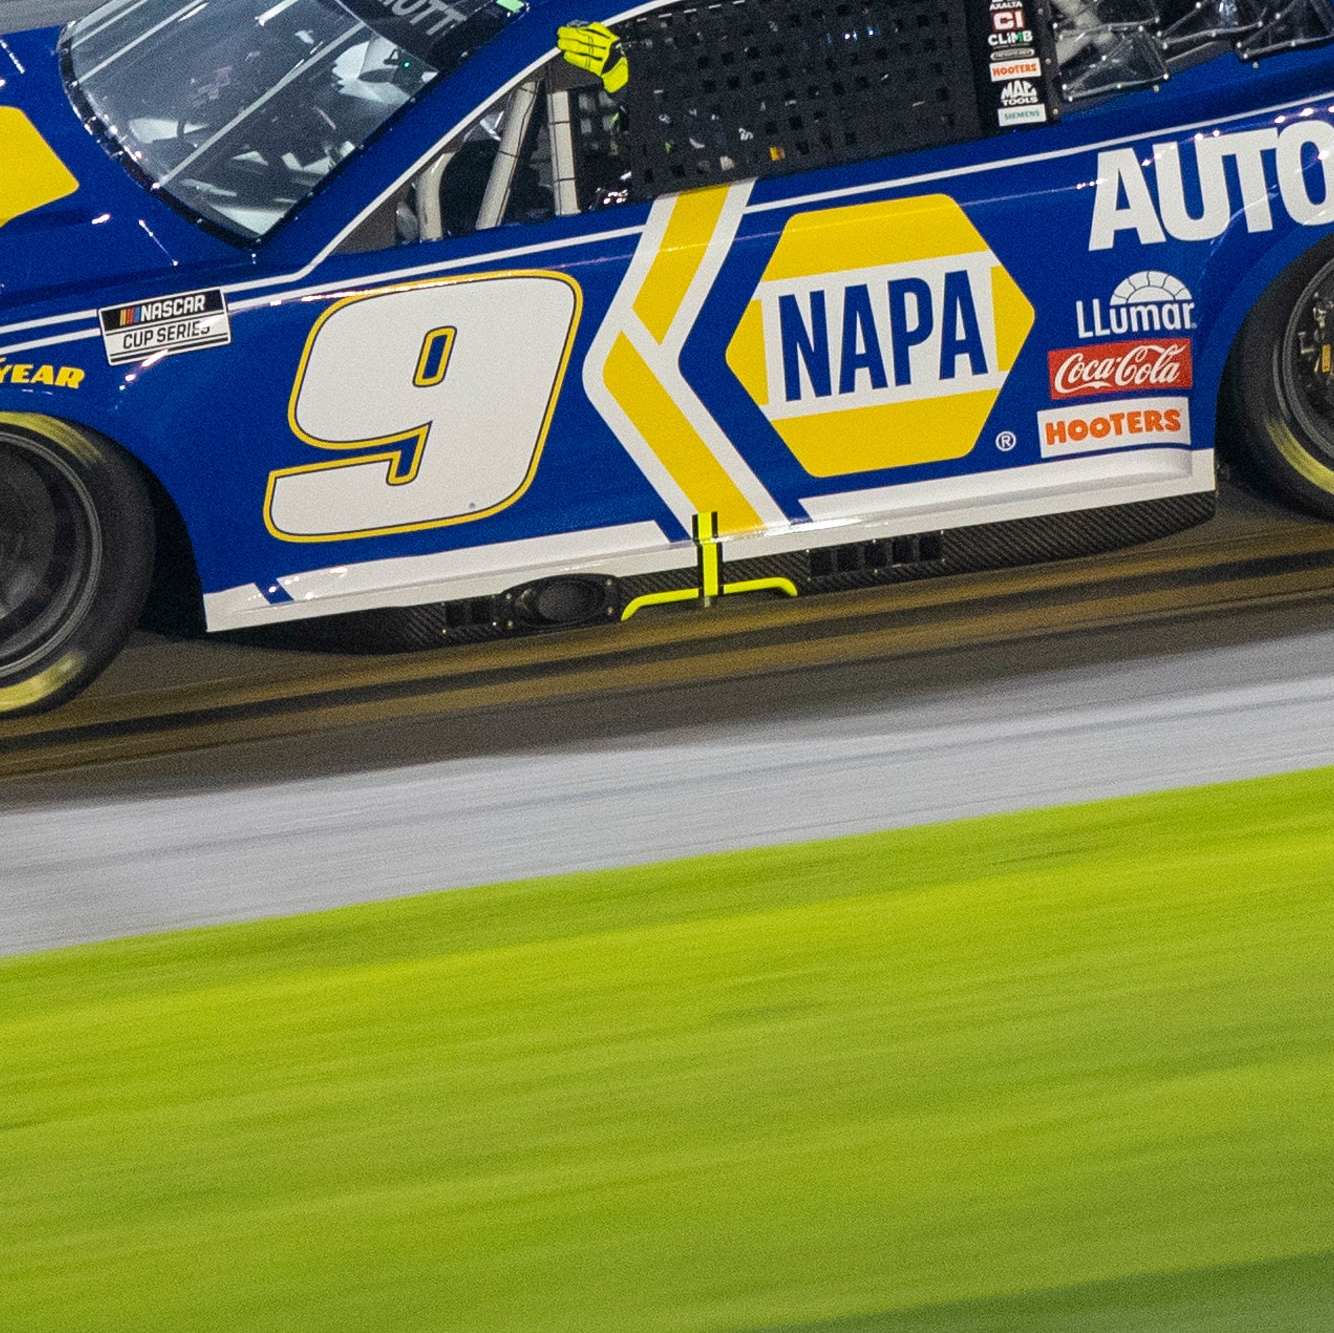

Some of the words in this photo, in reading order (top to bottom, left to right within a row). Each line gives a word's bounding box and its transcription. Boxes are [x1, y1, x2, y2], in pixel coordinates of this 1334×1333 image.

[989, 0, 1023, 11] AXALTA
[992, 63, 1037, 76] HOOTERS
[1001, 96, 1039, 107] TOOLS
[1004, 110, 1040, 121] SIEMENS
[141, 294, 206, 322] NASCAR
[1075, 298, 1195, 338] LLumar
[123, 330, 154, 349] CUP
[779, 270, 988, 402] NAPA
[263, 269, 583, 543] 9
[1045, 409, 1181, 445] HOOTERS
